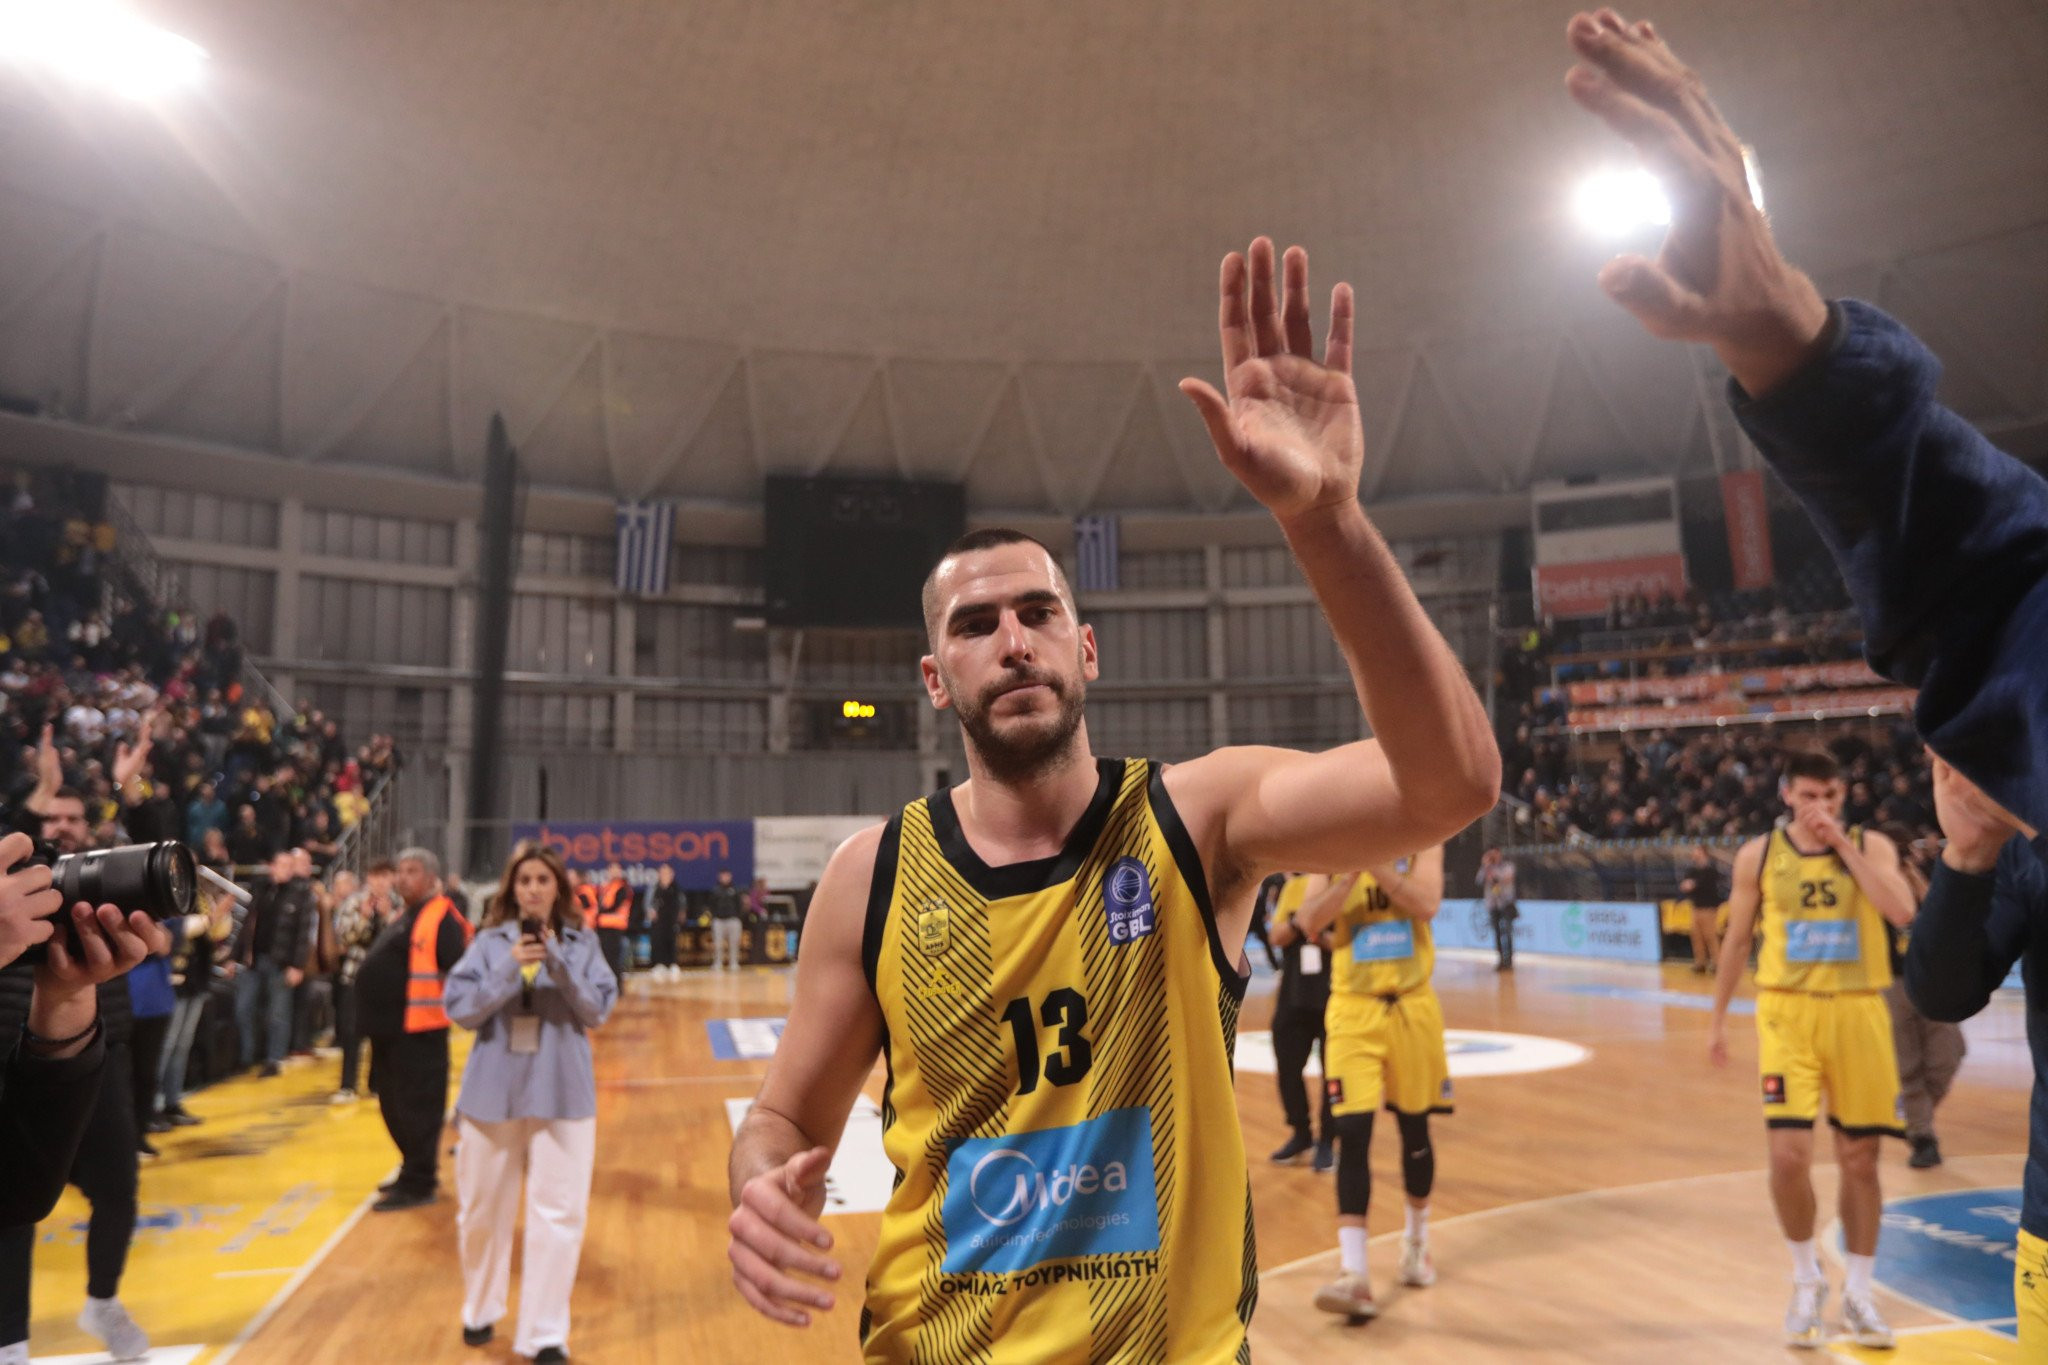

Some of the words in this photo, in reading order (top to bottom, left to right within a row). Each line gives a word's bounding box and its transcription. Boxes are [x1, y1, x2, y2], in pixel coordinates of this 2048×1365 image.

[1800, 881, 1837, 908] 25
[1113, 914, 1152, 940] GBL
[1000, 987, 1093, 1096] 13
[986, 1157, 1127, 1217] Midea
